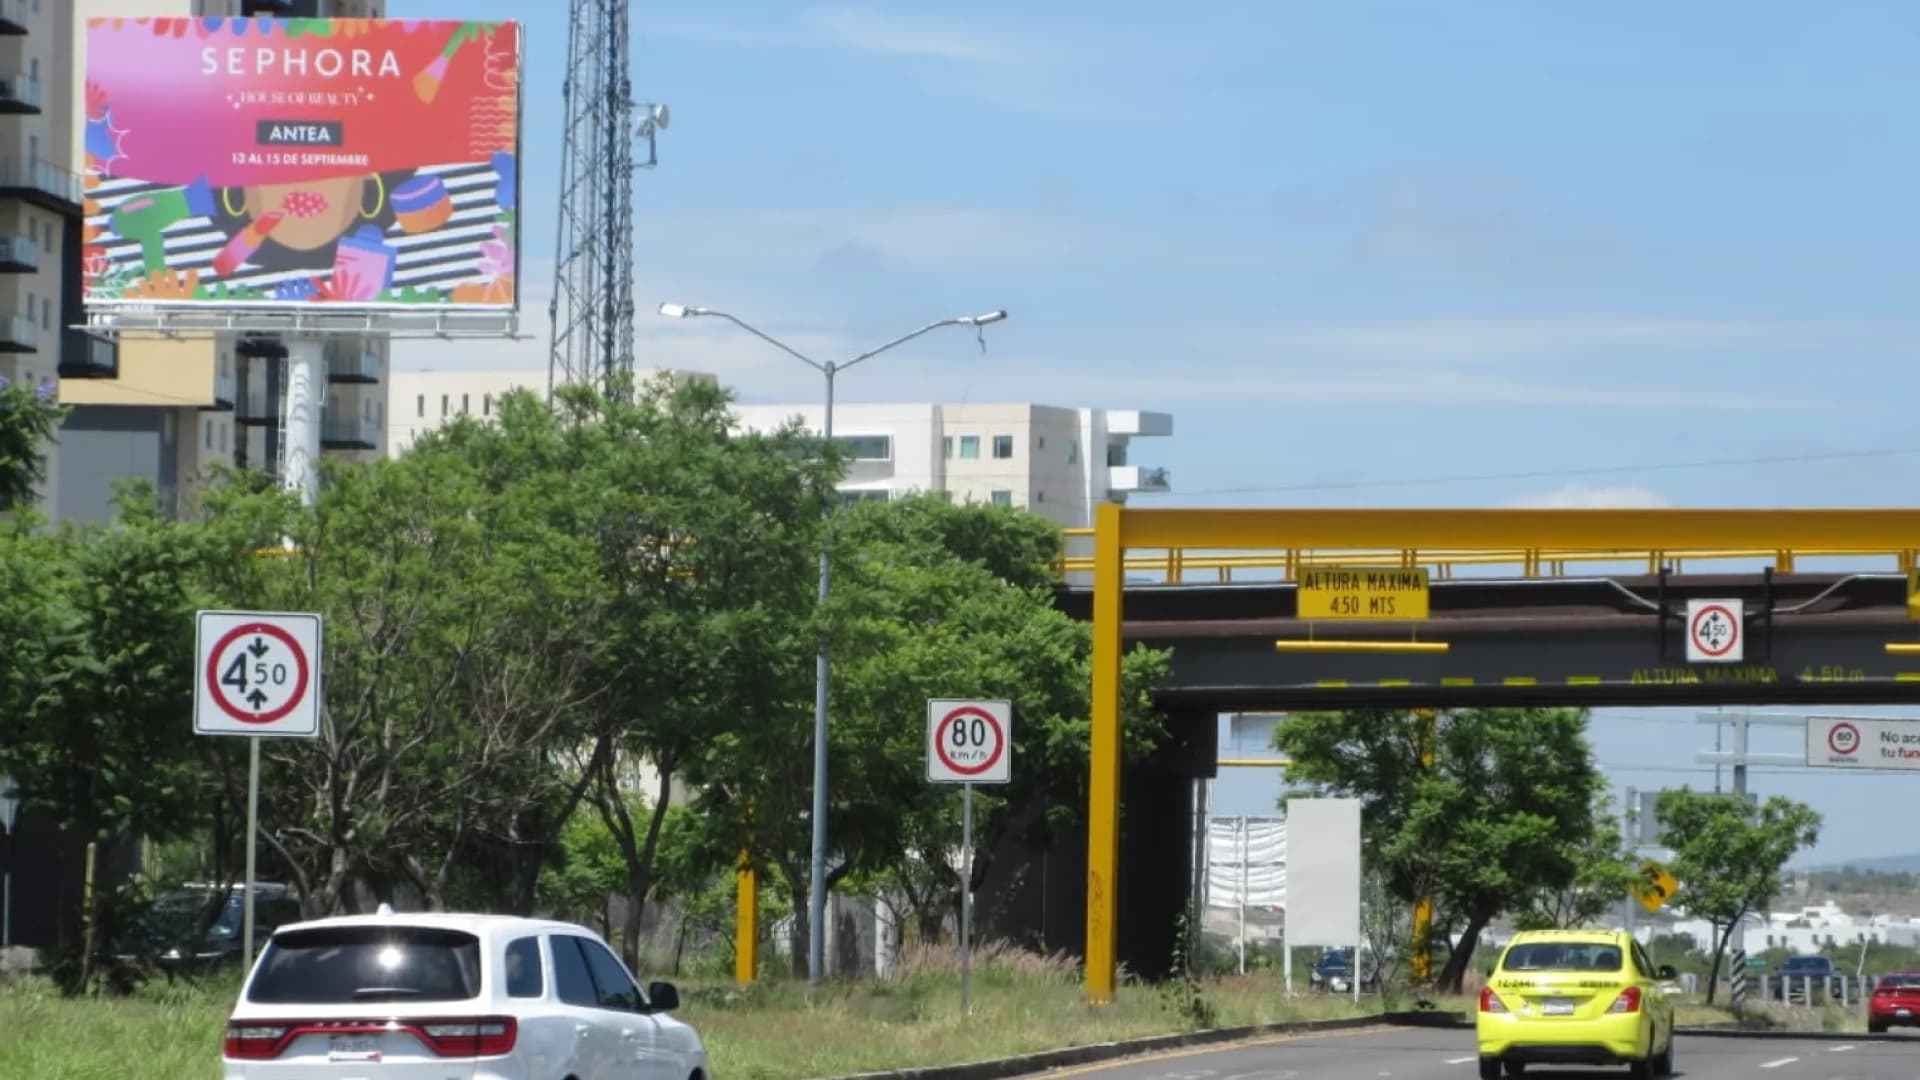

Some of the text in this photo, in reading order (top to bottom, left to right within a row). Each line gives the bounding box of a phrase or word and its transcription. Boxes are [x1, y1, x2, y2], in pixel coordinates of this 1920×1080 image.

[201, 48, 400, 77] SEPHORA
[269, 125, 331, 142] ANTEA
[248, 152, 263, 164] AL
[266, 152, 281, 165] 15
[283, 153, 298, 165] DE
[301, 153, 368, 166] SEPTIEMBRE
[1305, 571, 1421, 592] ALTURA MAXIMA
[1369, 597, 1395, 614] MTS
[1631, 668, 1699, 684] ALTURA
[952, 719, 986, 747] 80
[1880, 731, 1900, 743] No
[1881, 747, 1896, 758] tu
